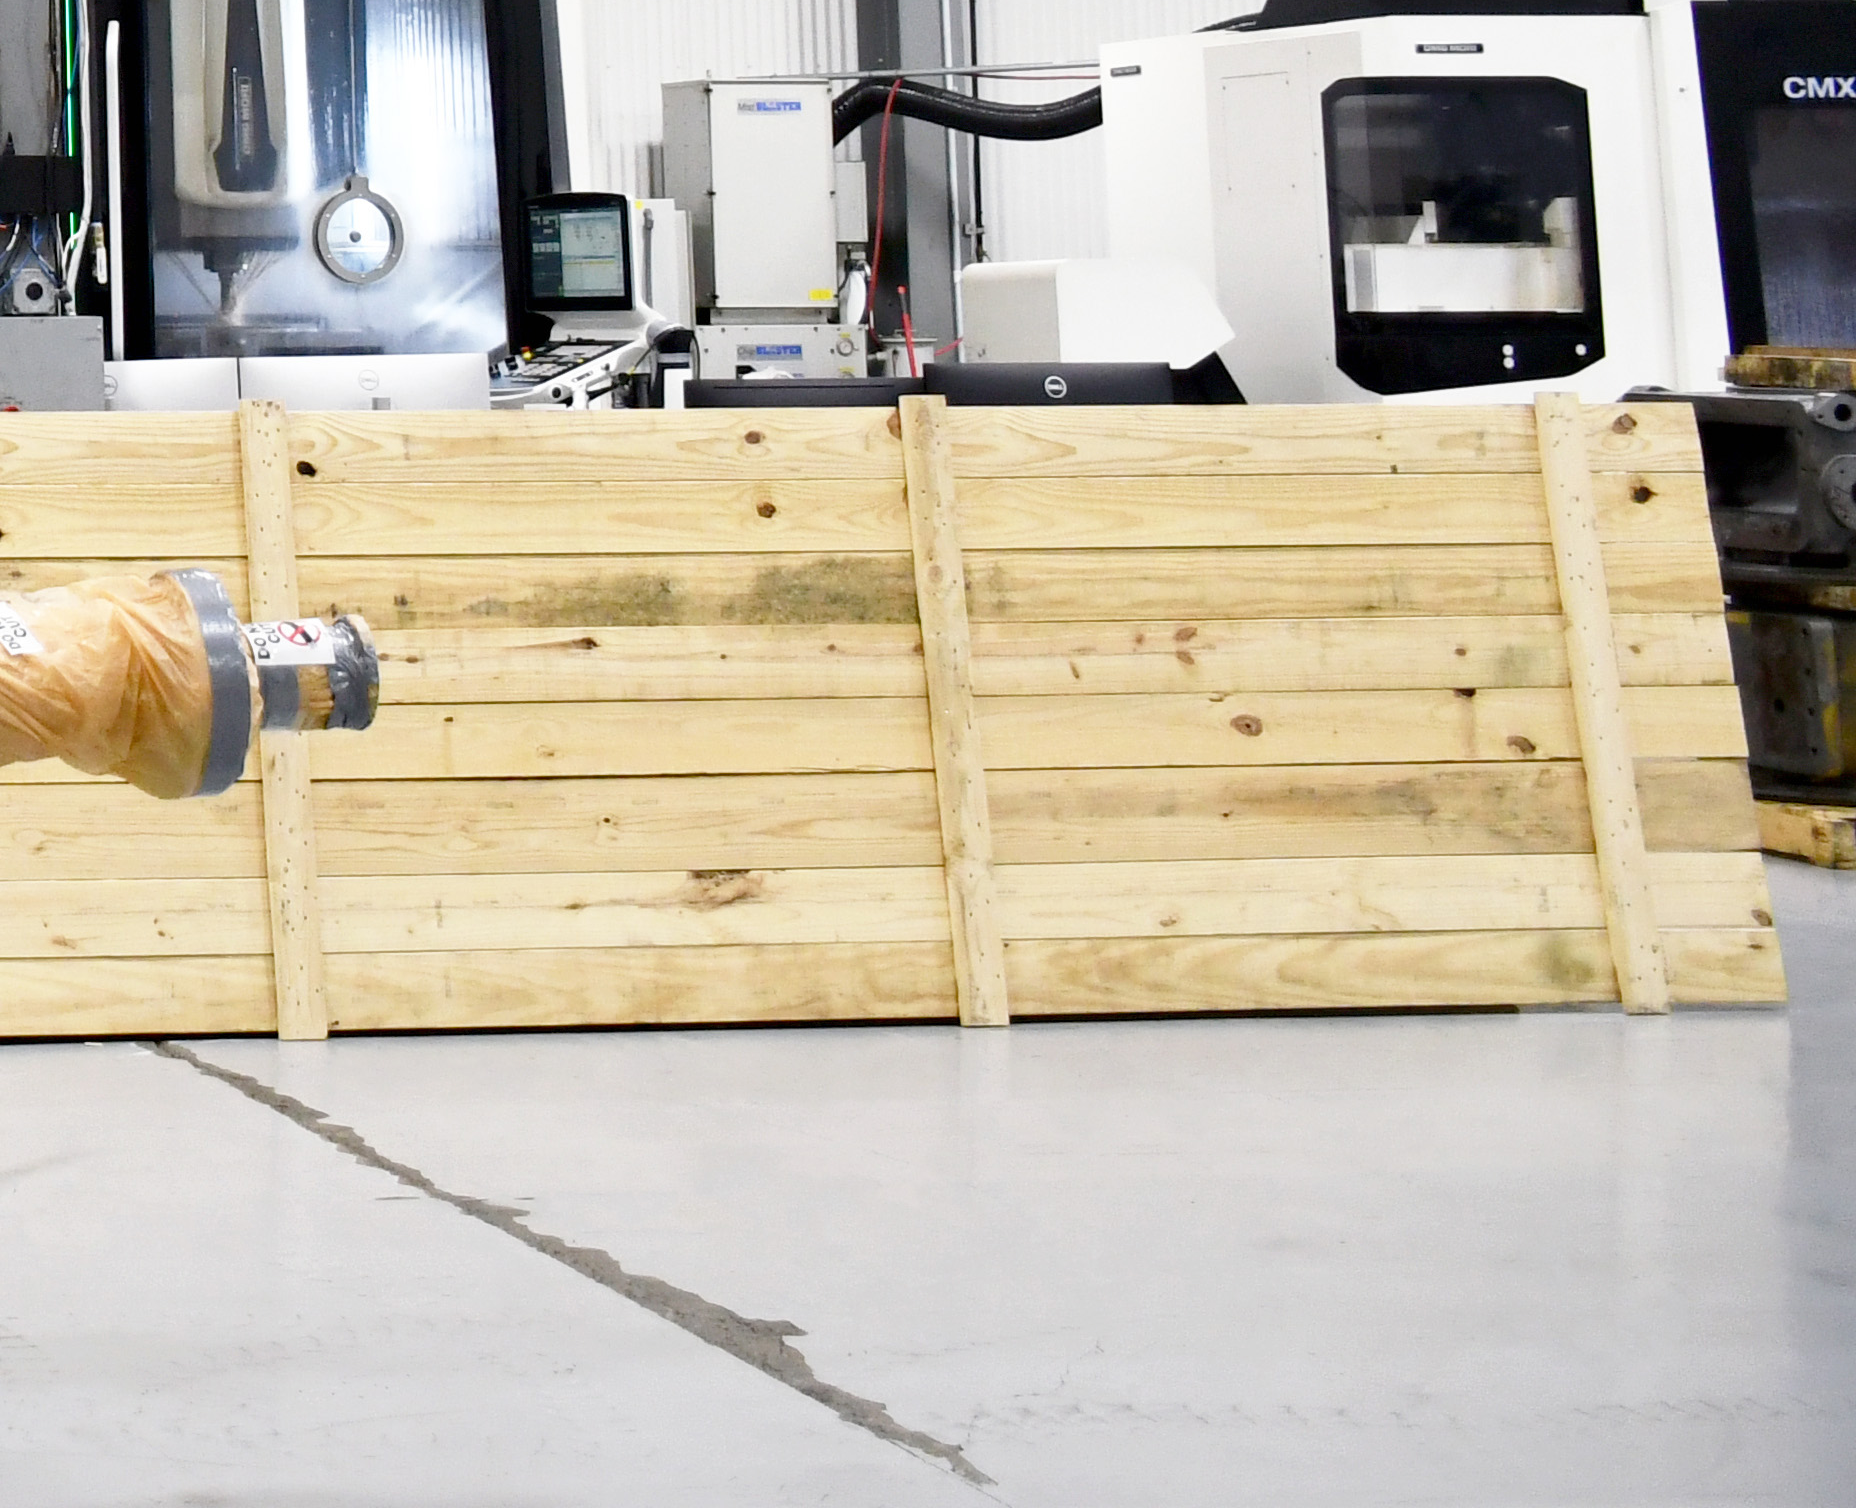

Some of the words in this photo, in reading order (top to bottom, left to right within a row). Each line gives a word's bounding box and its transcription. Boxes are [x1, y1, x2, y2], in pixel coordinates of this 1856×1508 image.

[1782, 76, 1856, 99] CMX
[0, 616, 27, 637] CUT
[2, 634, 22, 650] DO
[254, 637, 270, 660] DO
